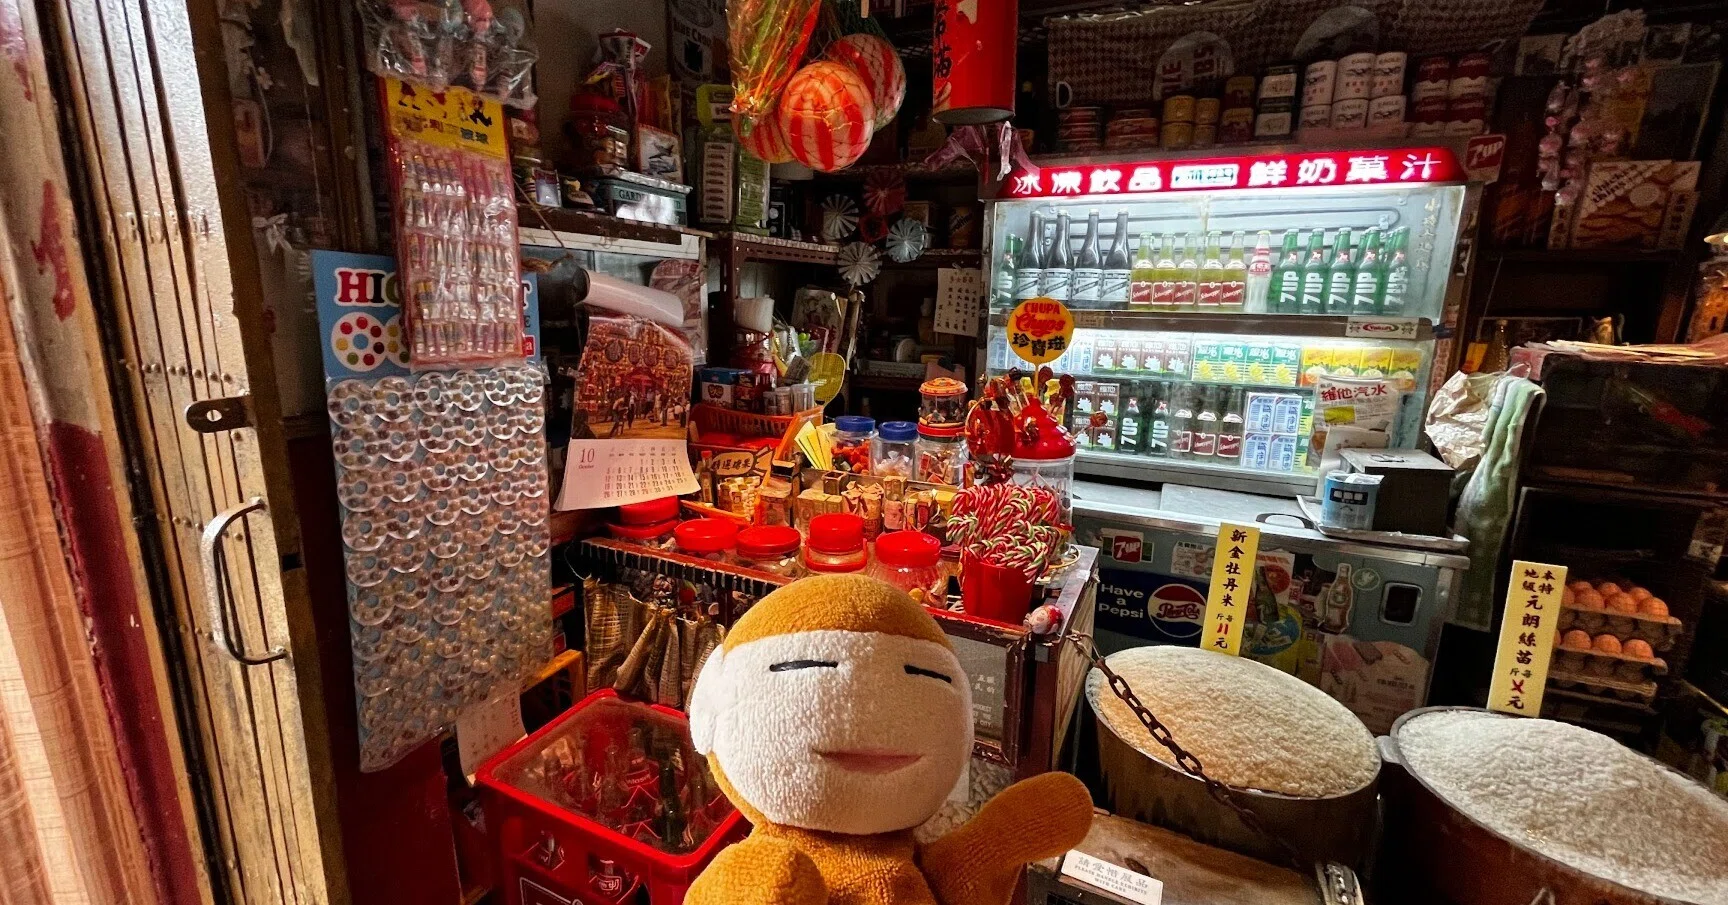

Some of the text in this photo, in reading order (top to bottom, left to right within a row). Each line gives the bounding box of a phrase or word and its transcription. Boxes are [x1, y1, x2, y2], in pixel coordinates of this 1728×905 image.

[1280, 271, 1299, 302] 7UP
[1303, 272, 1323, 304] 7UP
[1329, 272, 1350, 305] 7UP
[1354, 272, 1377, 305] 7UP
[1024, 303, 1060, 314] CHUPA
[1016, 313, 1066, 337] Chups
[1012, 333, 1066, 357] 珍寶珠
[1321, 385, 1388, 402] 維他汽水
[1121, 418, 1138, 445] 7UP
[1151, 421, 1169, 448] 7UP
[580, 448, 595, 463] 10
[1115, 541, 1141, 558] 7UP
[1222, 529, 1247, 607] 新金牡丹米
[1101, 584, 1144, 598] Have
[1117, 597, 1126, 606] a
[1098, 603, 1144, 619] Pepsi
[1075, 865, 1147, 895] PLEASE HANDLE EXHIBITS
[1078, 856, 1148, 889] 請愛惜展品
[1095, 877, 1126, 893] WITH CARE
